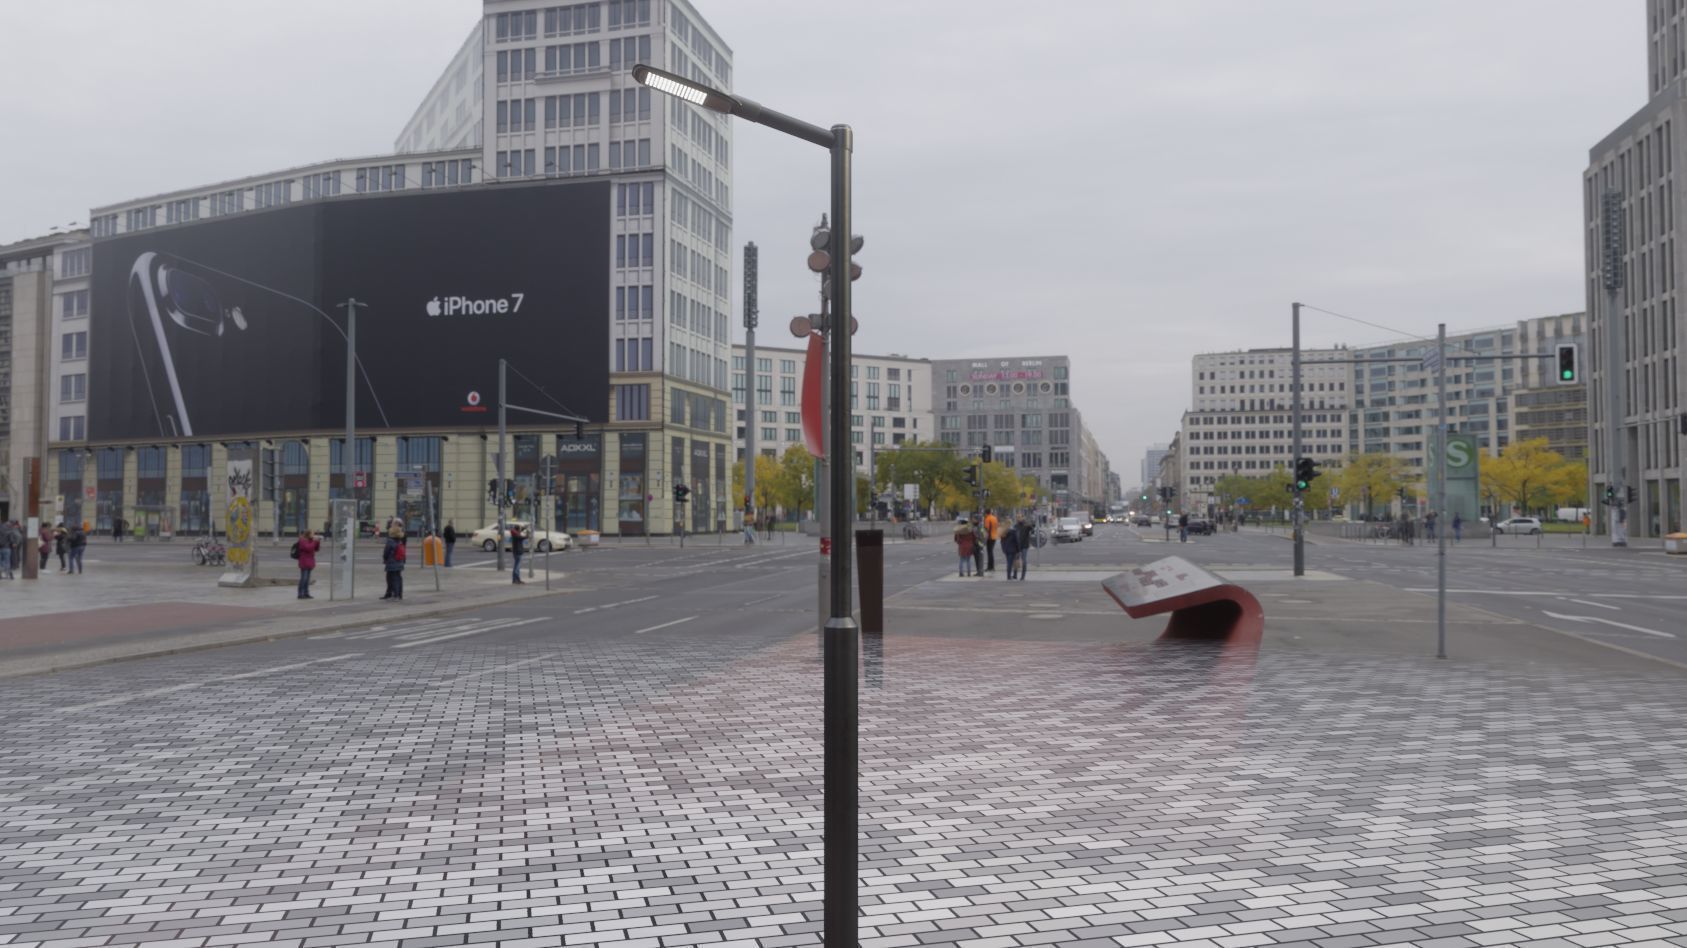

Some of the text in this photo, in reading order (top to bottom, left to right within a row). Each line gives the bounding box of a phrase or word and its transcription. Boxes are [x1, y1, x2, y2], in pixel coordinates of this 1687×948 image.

[443, 293, 525, 316] iPhone 7
[1447, 440, 1469, 467] S
